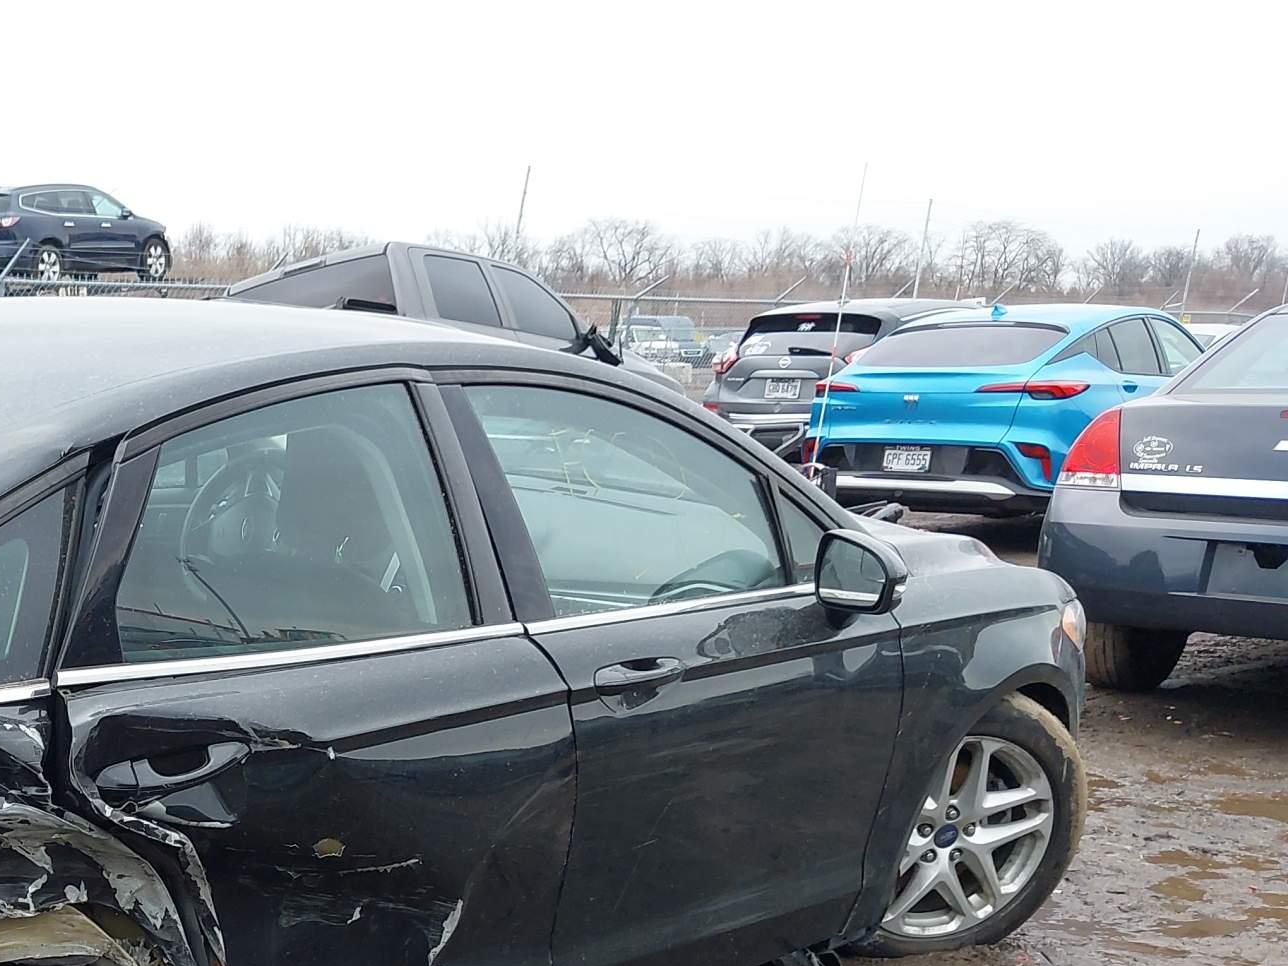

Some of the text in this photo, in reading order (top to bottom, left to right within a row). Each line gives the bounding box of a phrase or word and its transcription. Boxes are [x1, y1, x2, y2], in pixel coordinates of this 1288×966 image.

[886, 452, 929, 467] GPF 6555
[1129, 462, 1203, 473] IMPALA LS
